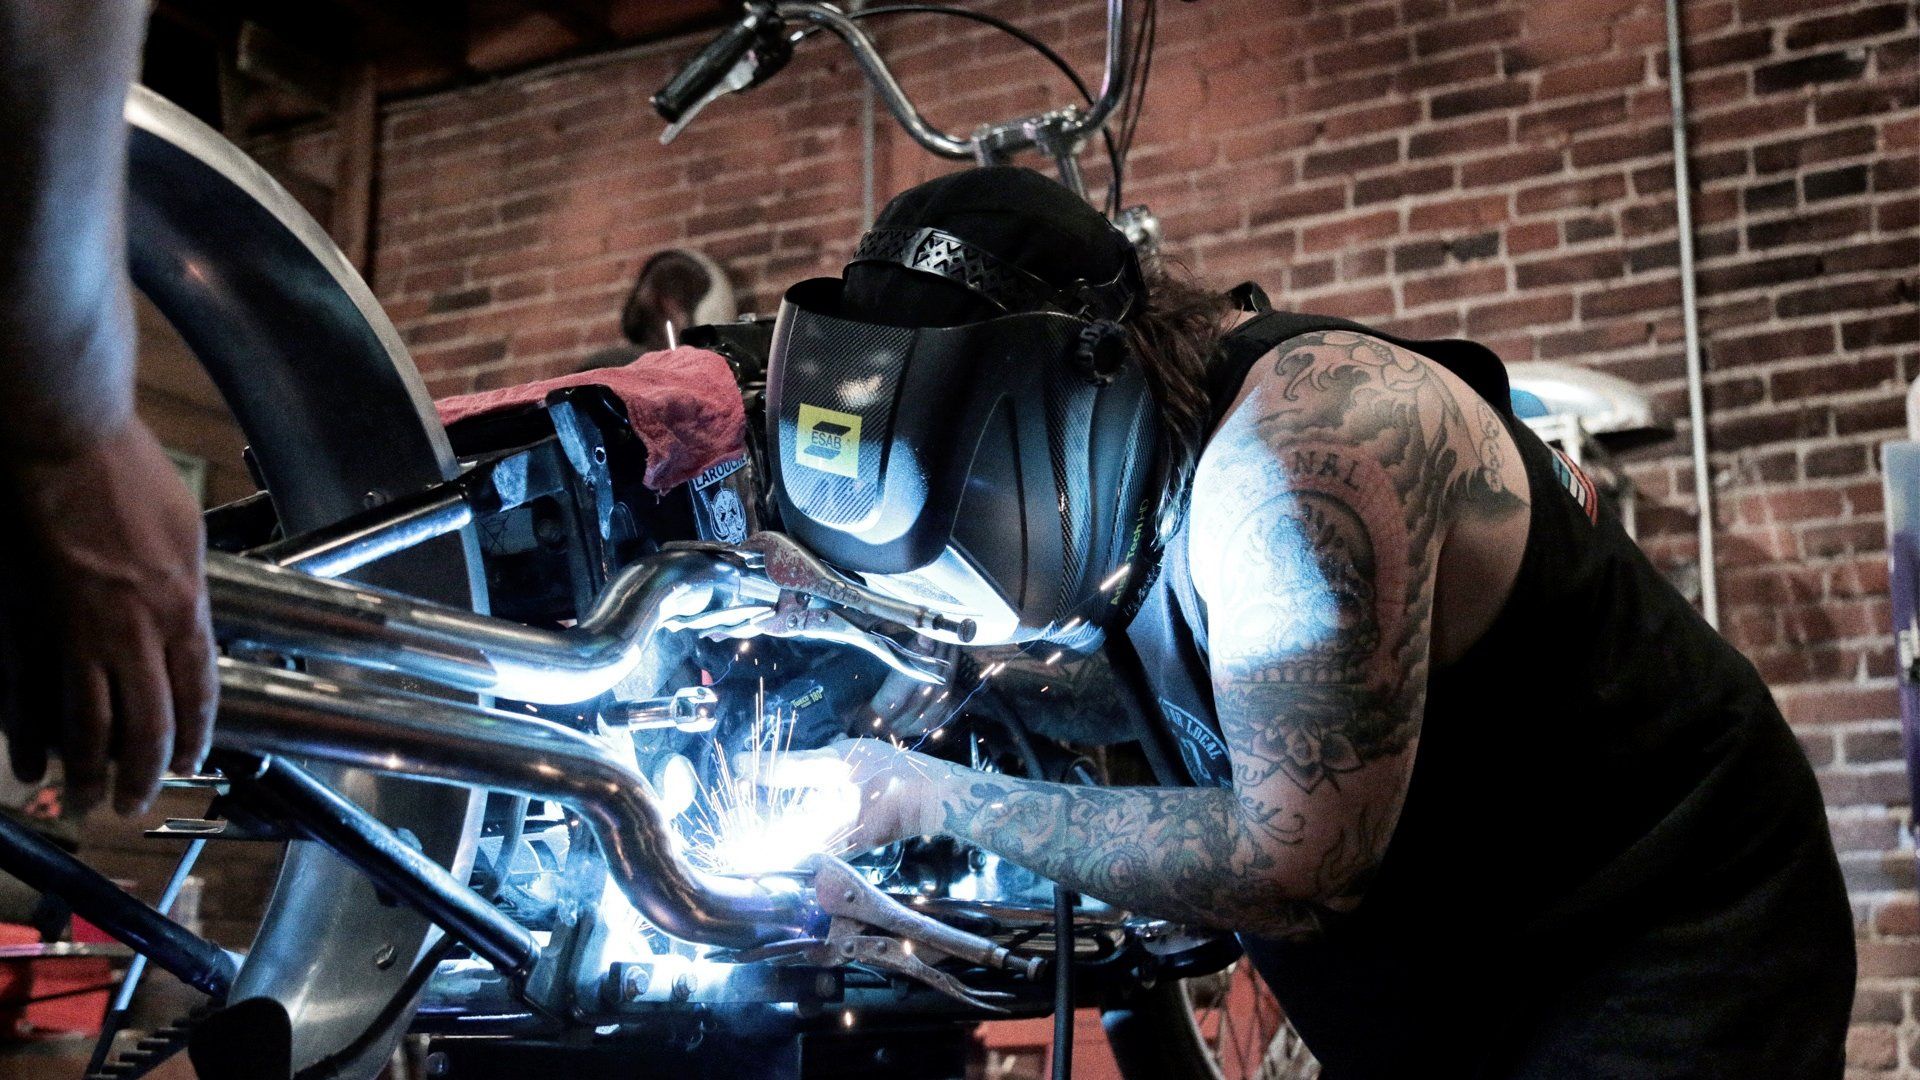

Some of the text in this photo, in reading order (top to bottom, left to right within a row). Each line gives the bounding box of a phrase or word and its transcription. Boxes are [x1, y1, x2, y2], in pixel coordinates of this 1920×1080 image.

[811, 431, 842, 448] ESAB
[1125, 523, 1143, 560] Tech
[1185, 719, 1223, 760] LOCAL
